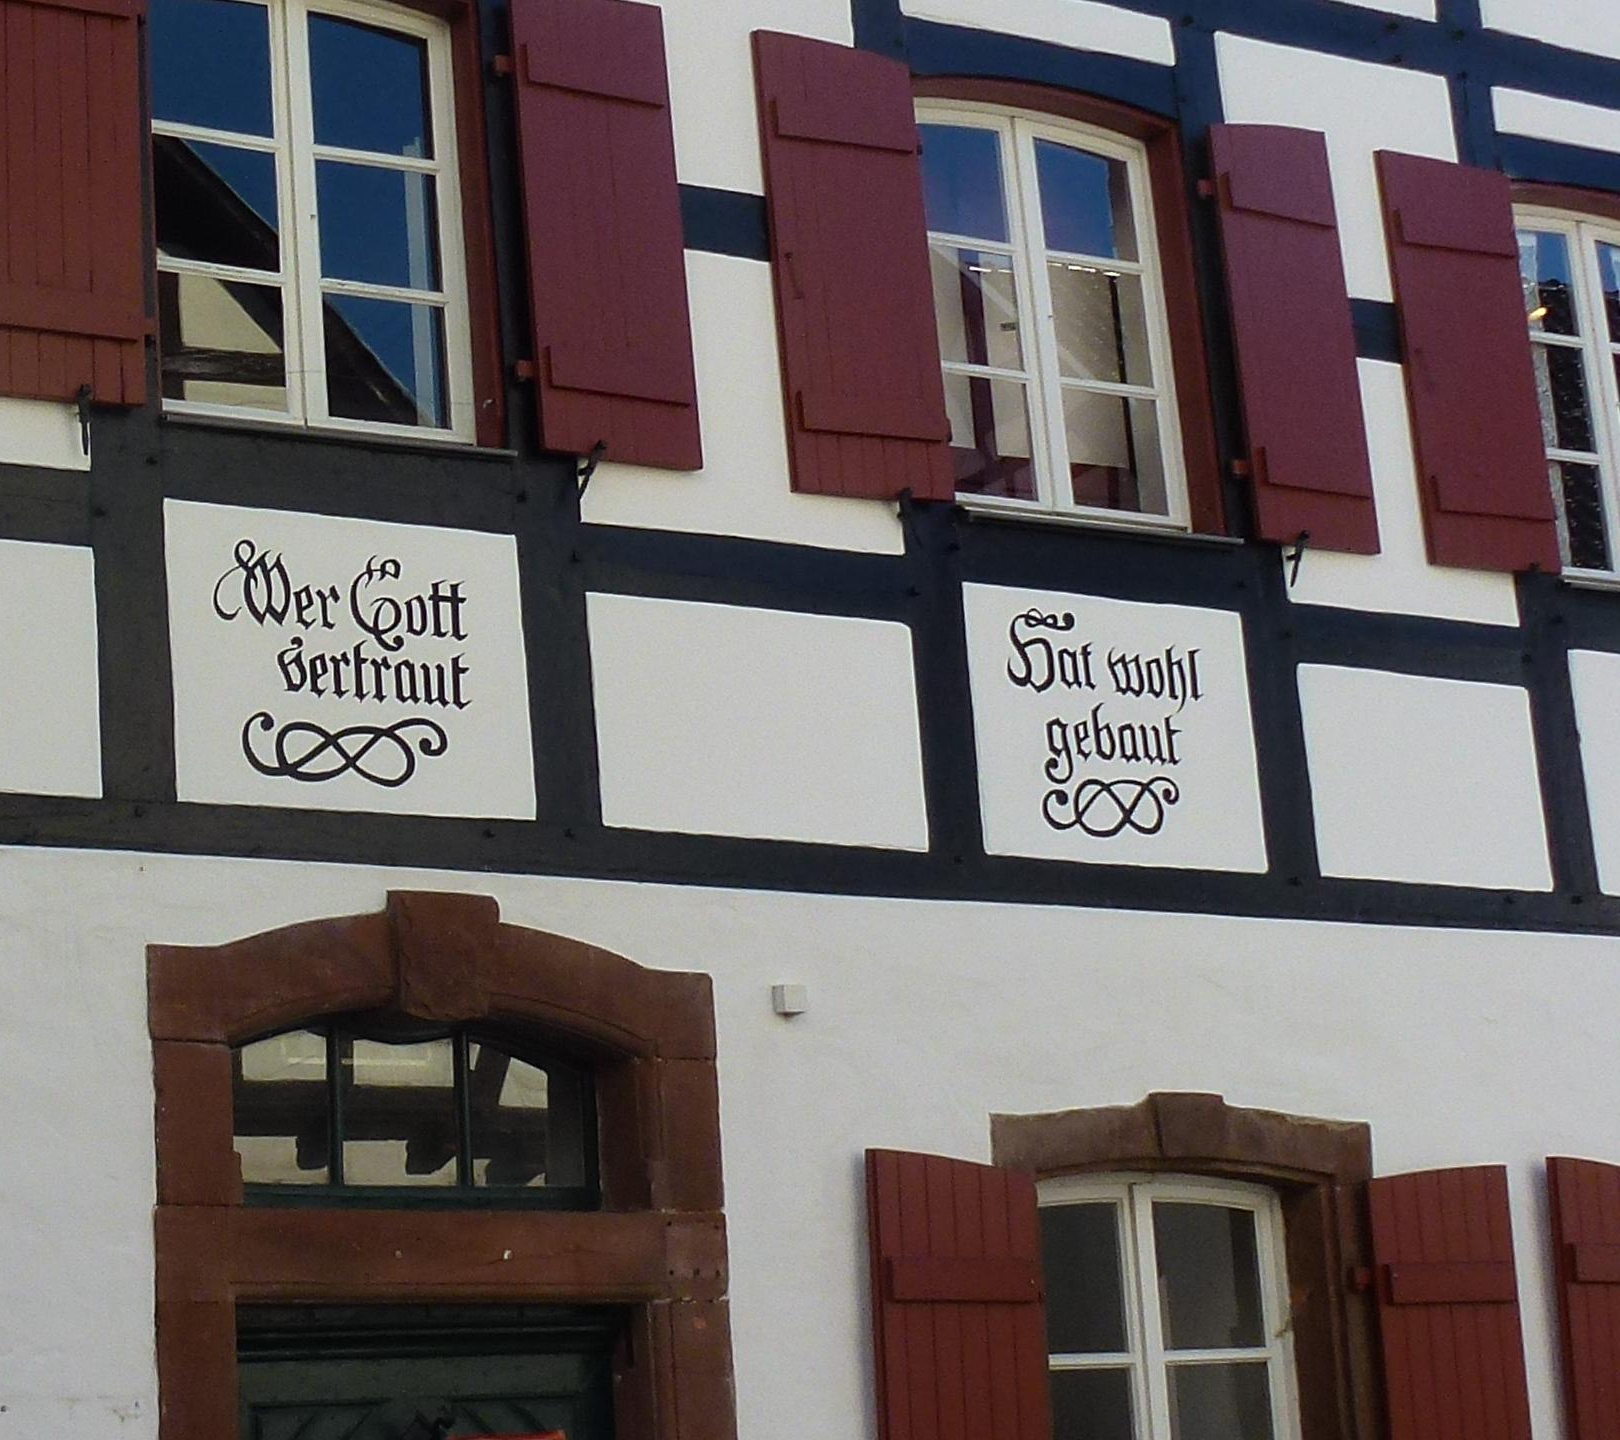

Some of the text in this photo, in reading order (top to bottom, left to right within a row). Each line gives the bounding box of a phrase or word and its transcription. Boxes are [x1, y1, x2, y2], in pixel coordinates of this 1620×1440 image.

[213, 539, 469, 652] Wer Gott
[1007, 607, 1204, 713] Hat wohl
[1044, 702, 1182, 785] gebaut
